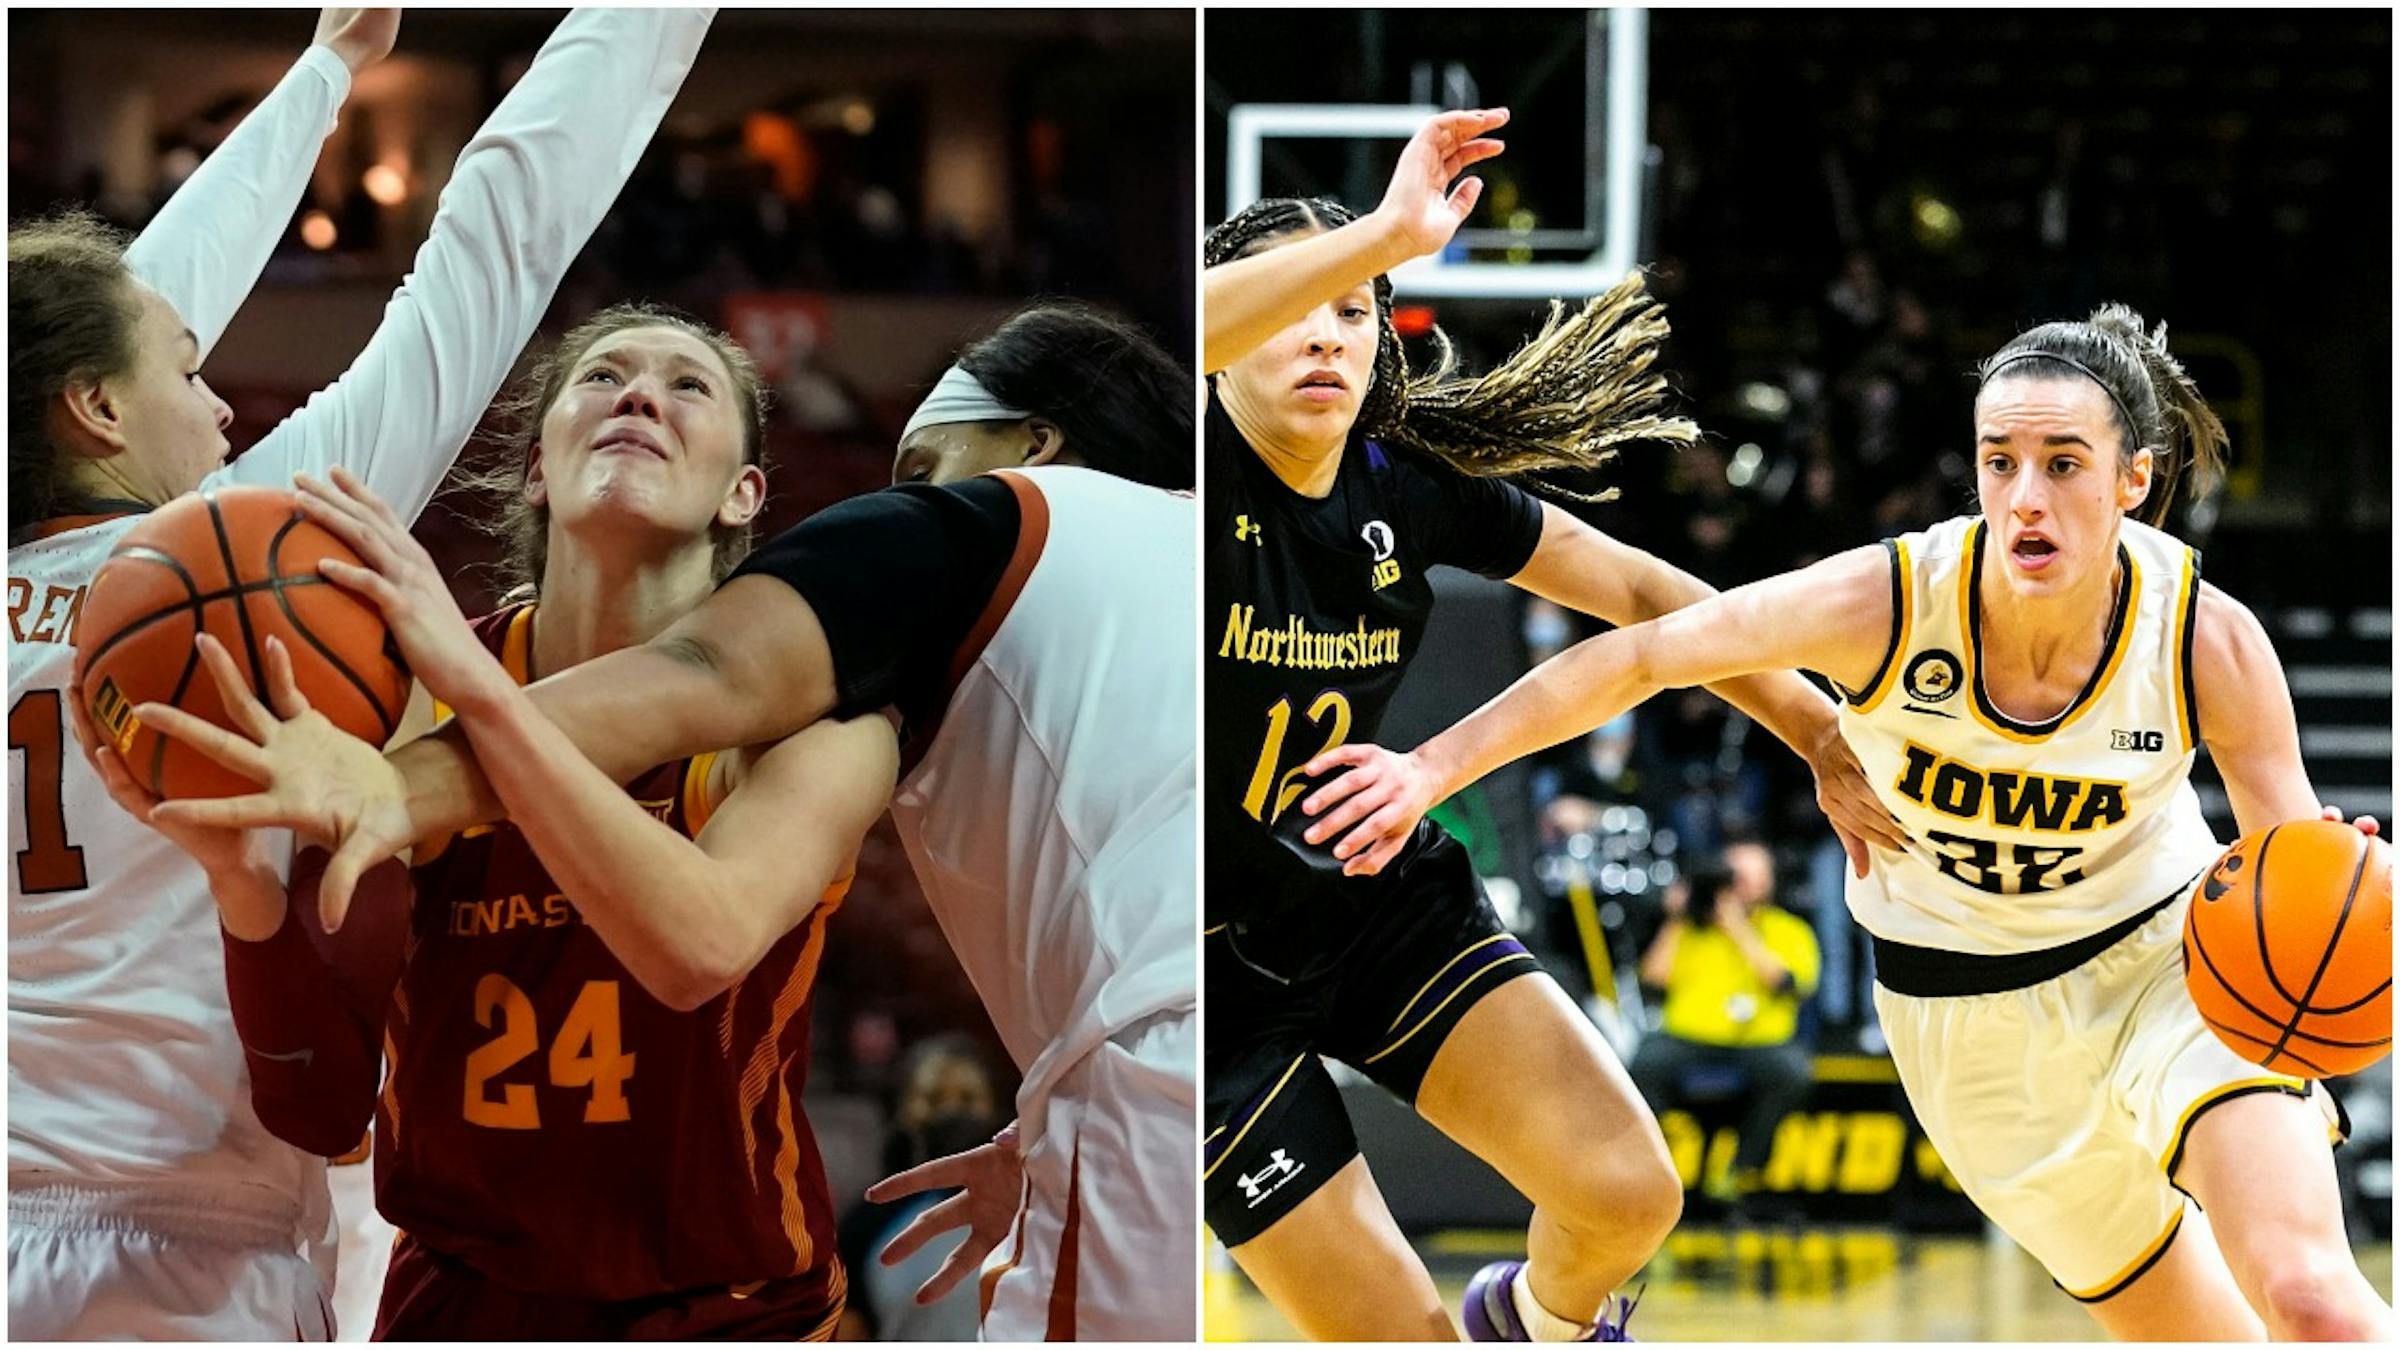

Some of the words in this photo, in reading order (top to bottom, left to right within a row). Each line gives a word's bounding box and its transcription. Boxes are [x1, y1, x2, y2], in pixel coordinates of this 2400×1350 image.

[1218, 602, 1400, 670] Northwestern
[1241, 687, 1351, 826] 12
[1893, 739, 2131, 835] IOWA
[463, 973, 636, 1130] 24
